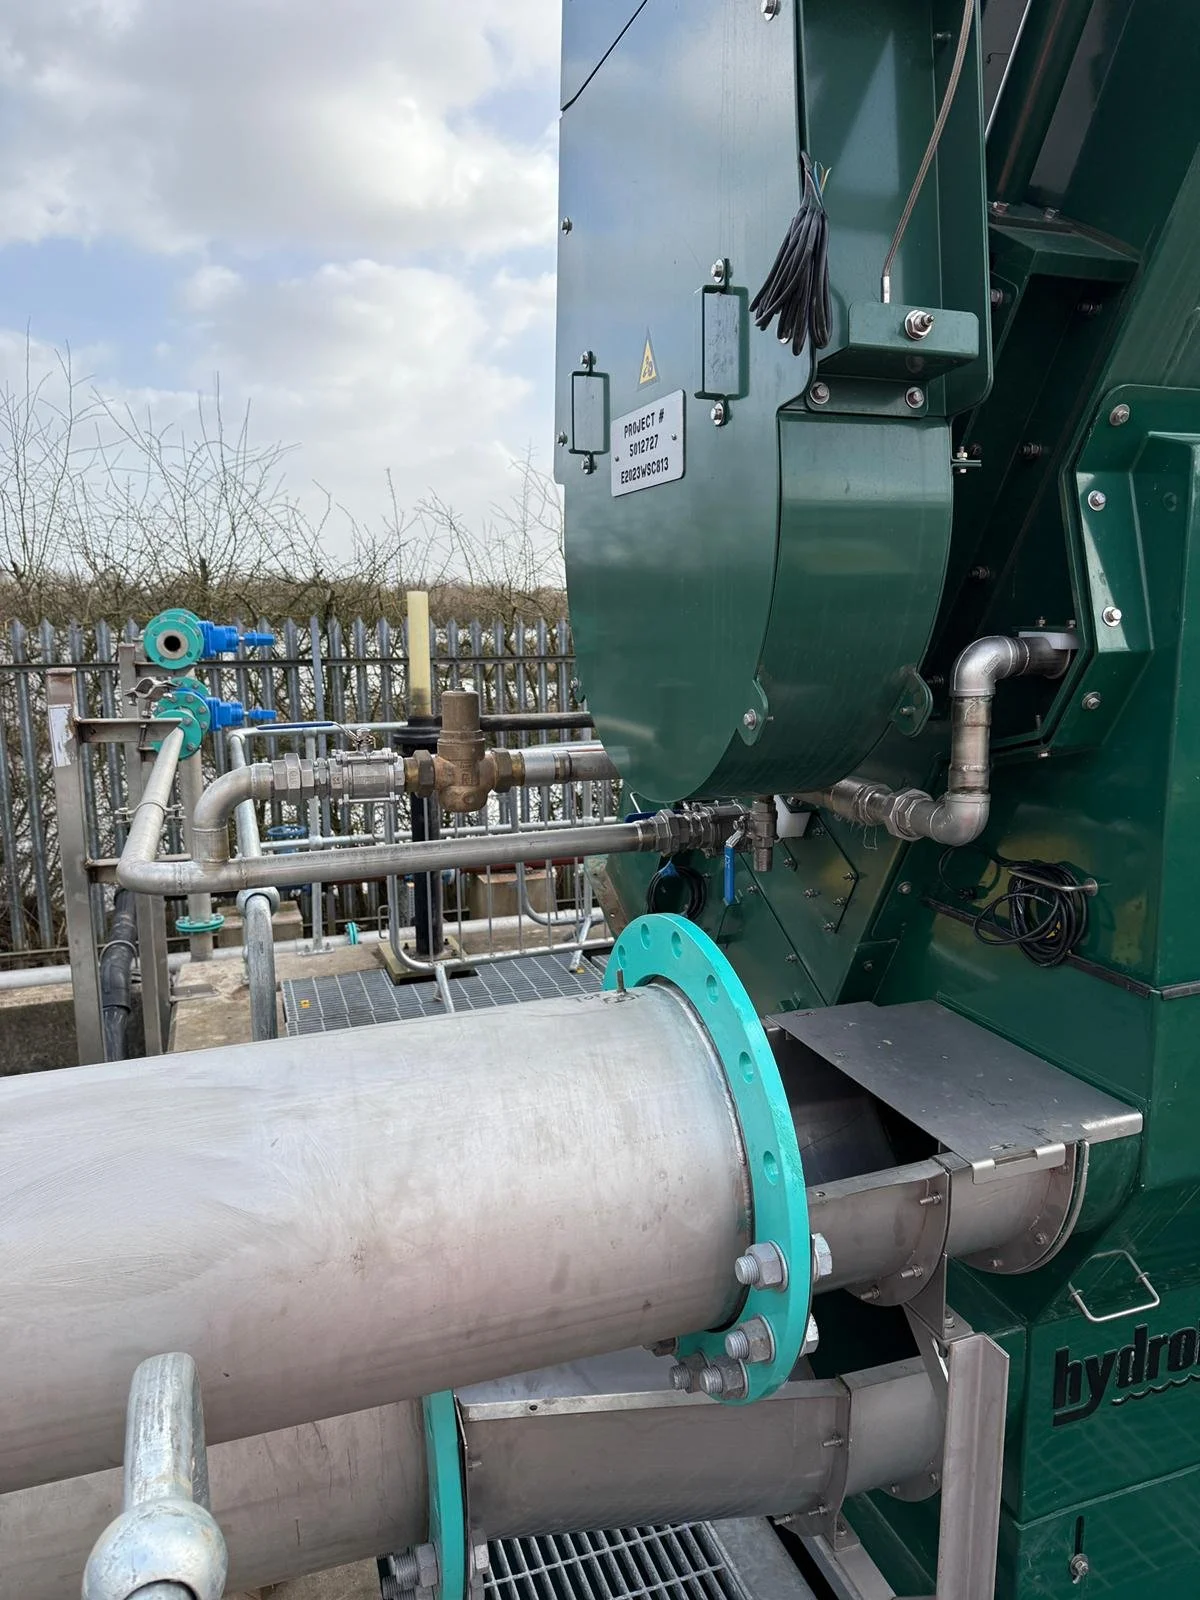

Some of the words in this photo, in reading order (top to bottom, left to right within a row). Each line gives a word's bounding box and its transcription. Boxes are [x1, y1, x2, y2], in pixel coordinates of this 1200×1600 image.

[624, 412, 655, 438] PROJECT
[658, 408, 665, 423] #
[629, 434, 659, 457] 5012727
[620, 456, 669, 484] E2023WSC813
[1053, 1321, 1200, 1427] hydro
